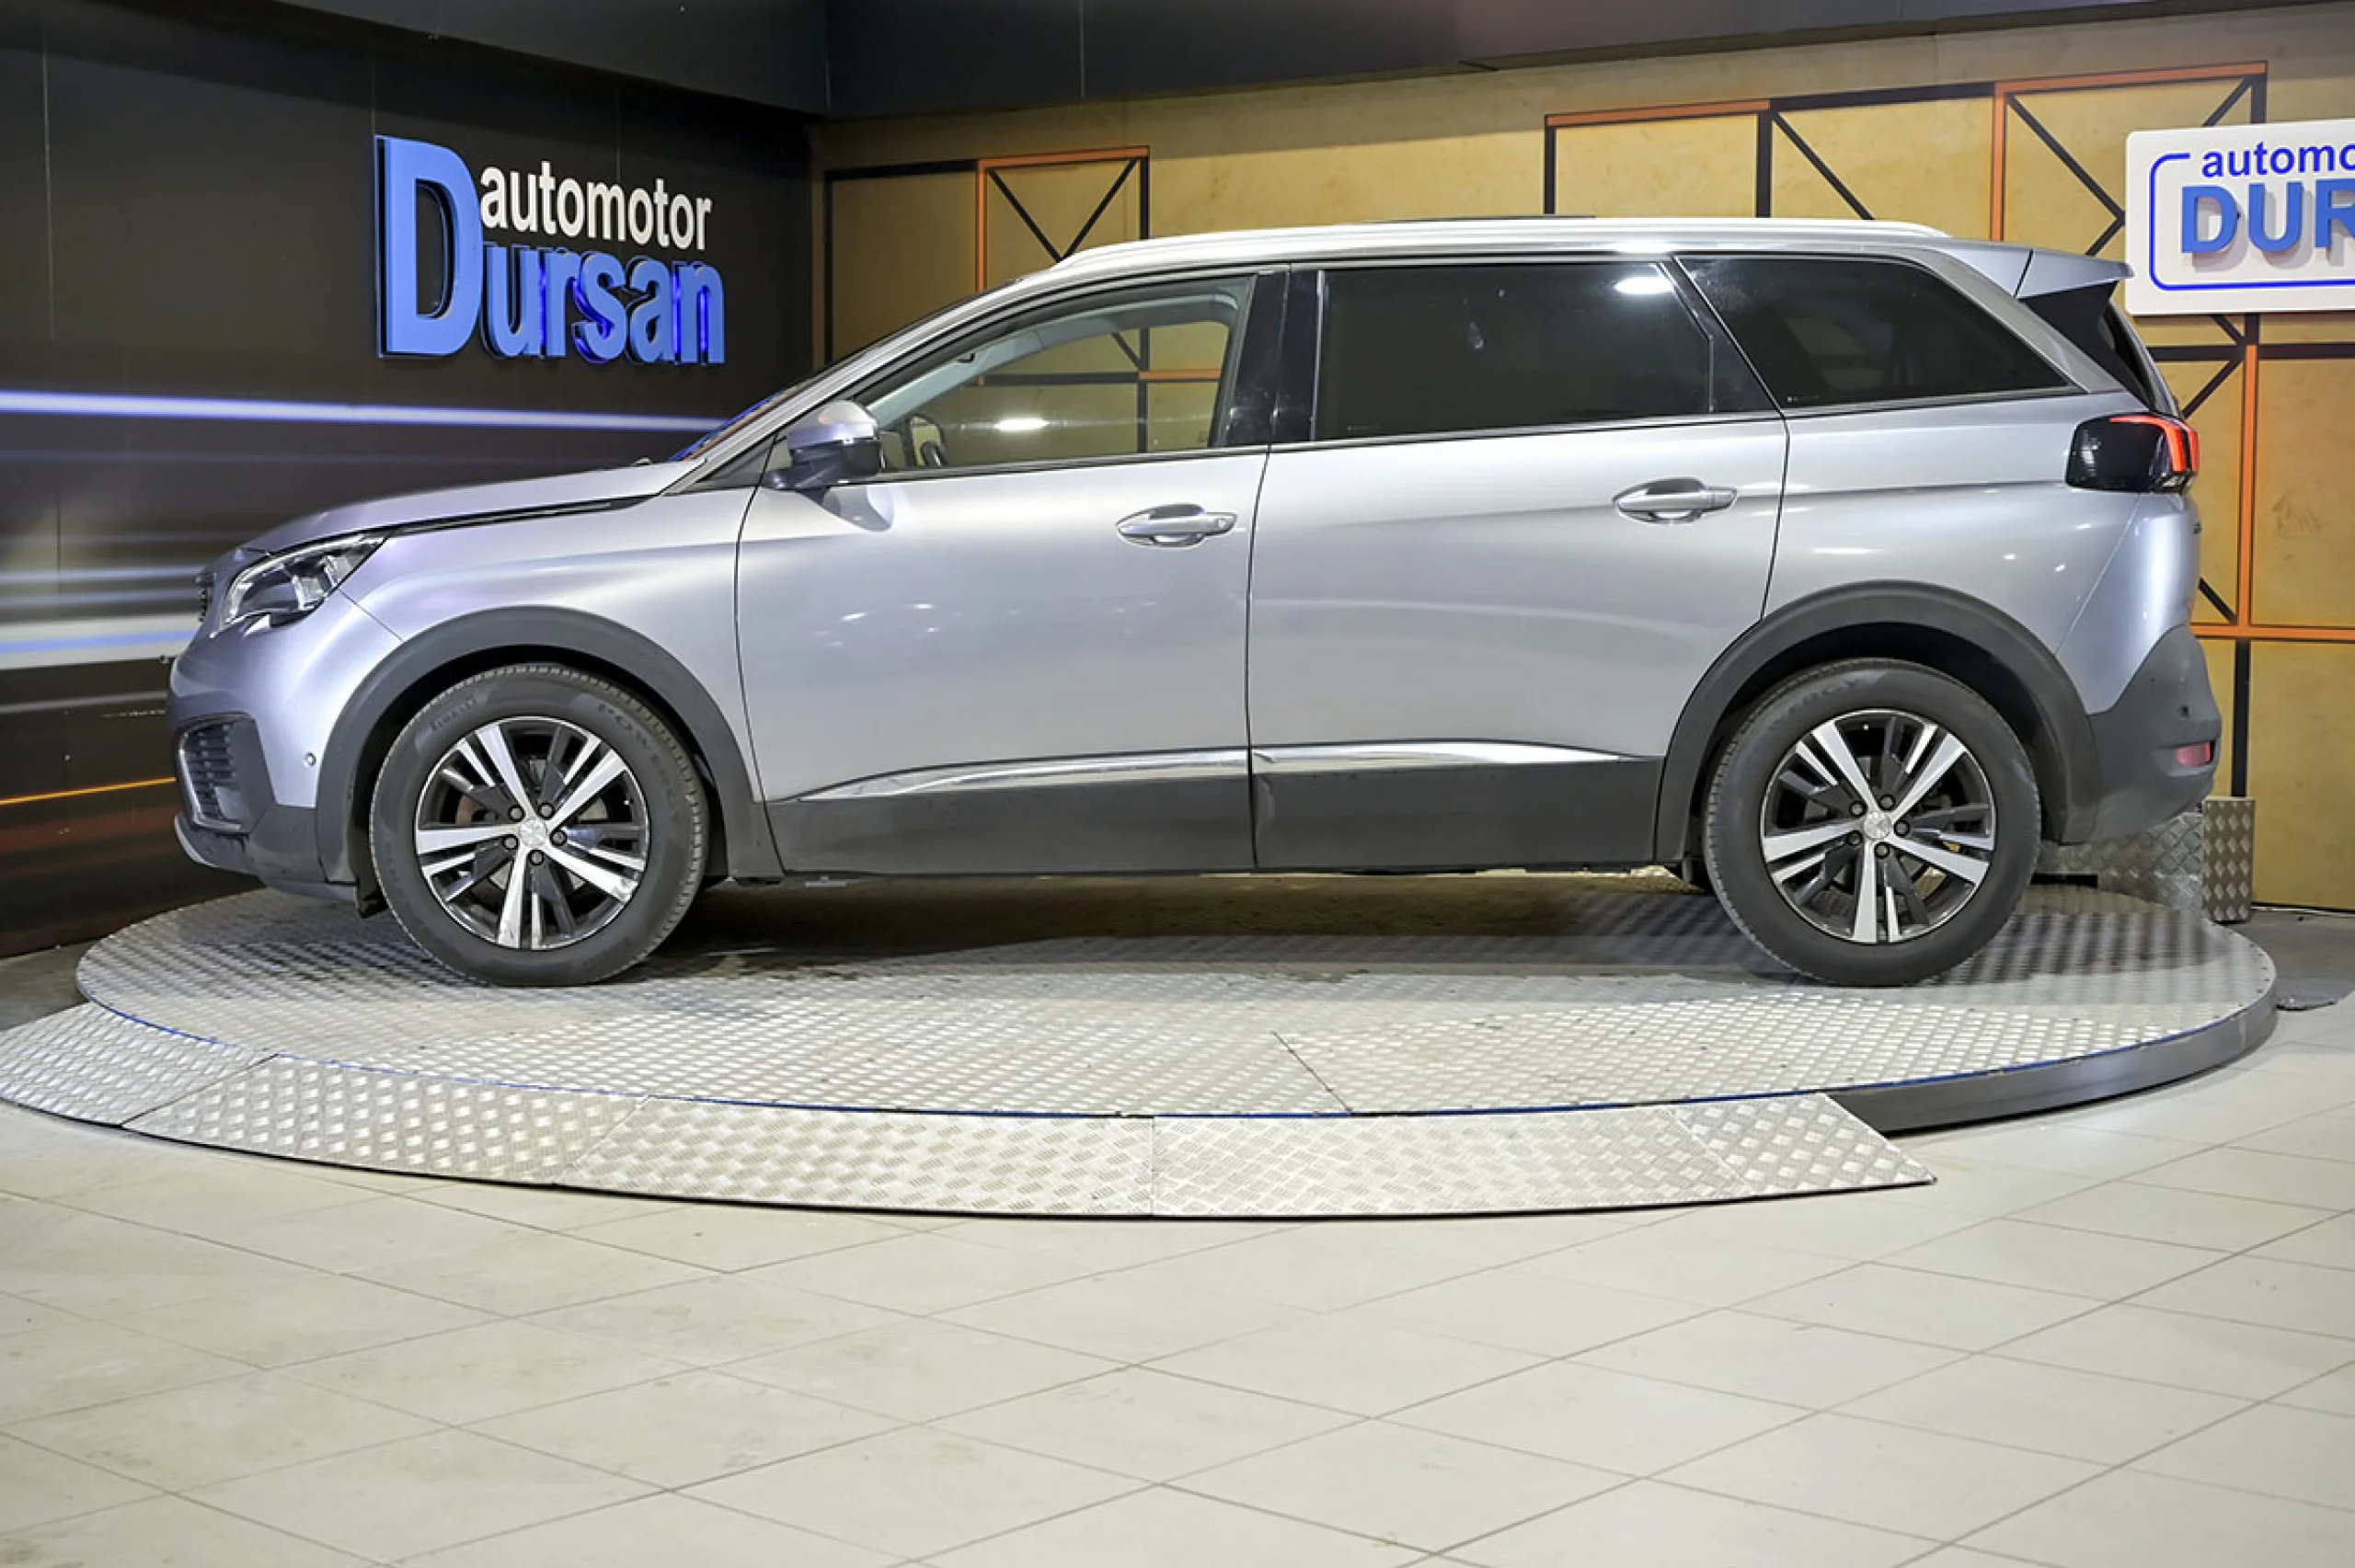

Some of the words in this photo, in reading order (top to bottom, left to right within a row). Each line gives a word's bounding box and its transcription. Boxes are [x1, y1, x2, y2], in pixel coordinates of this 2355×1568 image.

[374, 134, 725, 365] Dursan
[479, 160, 712, 250] automotor
[2181, 177, 2355, 254] DUR
